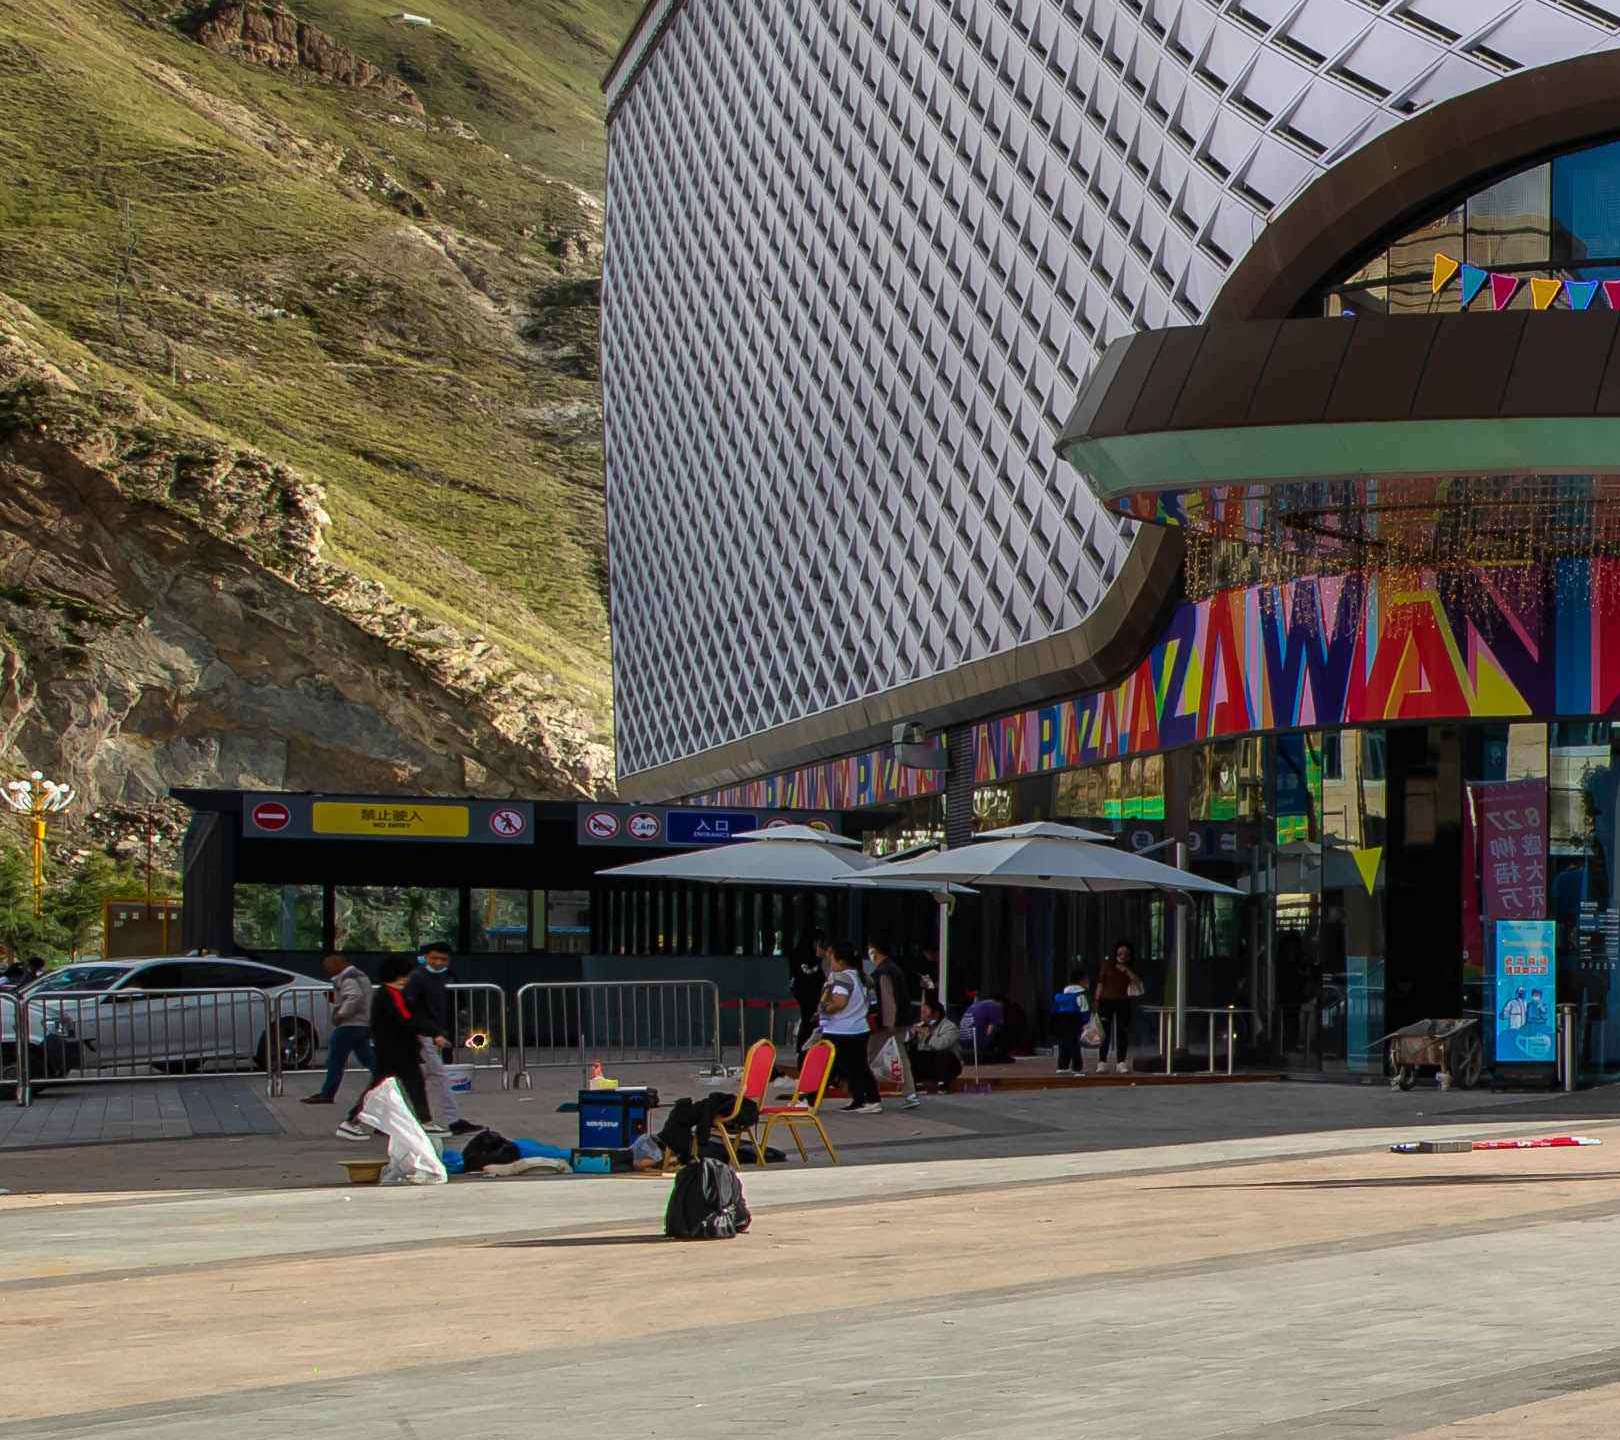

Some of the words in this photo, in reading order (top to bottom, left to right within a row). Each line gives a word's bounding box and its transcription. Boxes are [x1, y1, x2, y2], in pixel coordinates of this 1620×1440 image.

[361, 808, 424, 823] 禁止驶入
[697, 820, 729, 832] 入口
